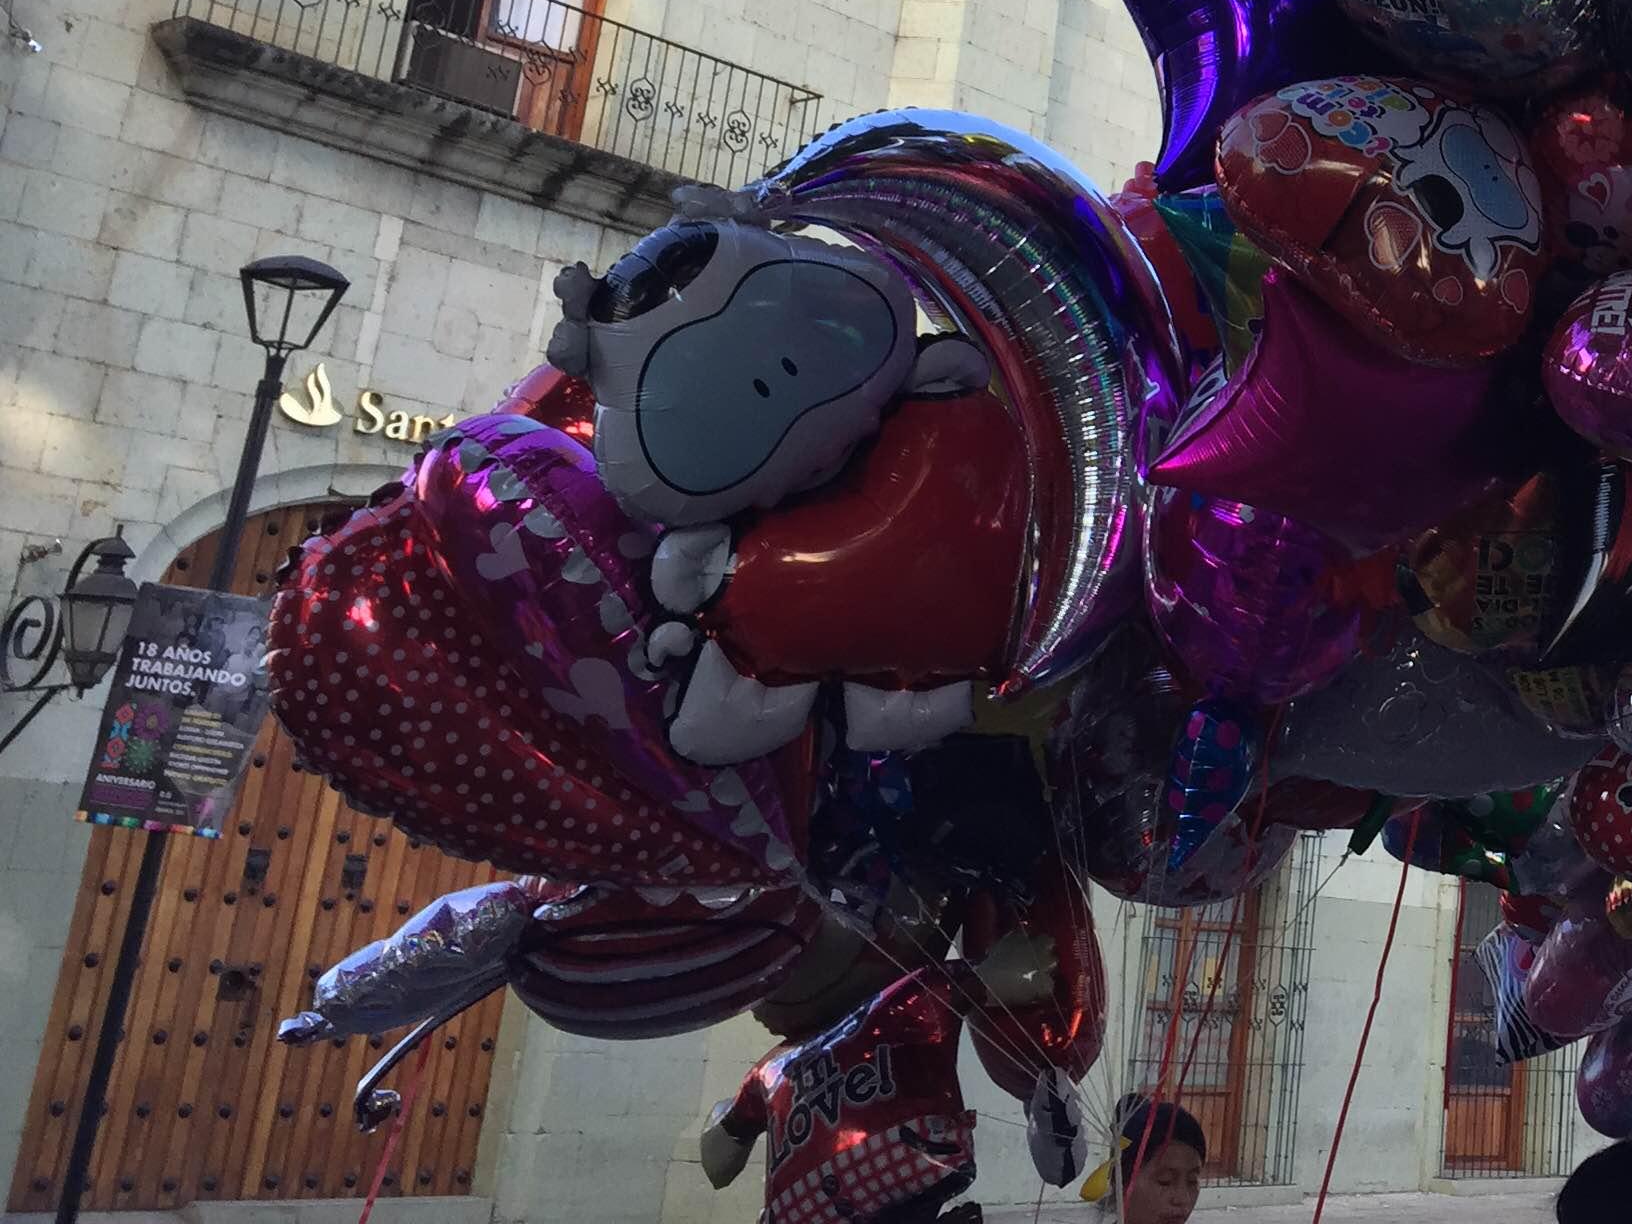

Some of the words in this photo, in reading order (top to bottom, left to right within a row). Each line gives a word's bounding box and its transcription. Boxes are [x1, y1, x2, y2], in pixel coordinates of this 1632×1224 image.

[137, 640, 160, 657] 18
[162, 644, 212, 664] AÑOS
[131, 656, 247, 688] TRABAJANDO
[124, 673, 197, 697] JUNTOS.
[95, 773, 157, 791] ANIVERSARIO
